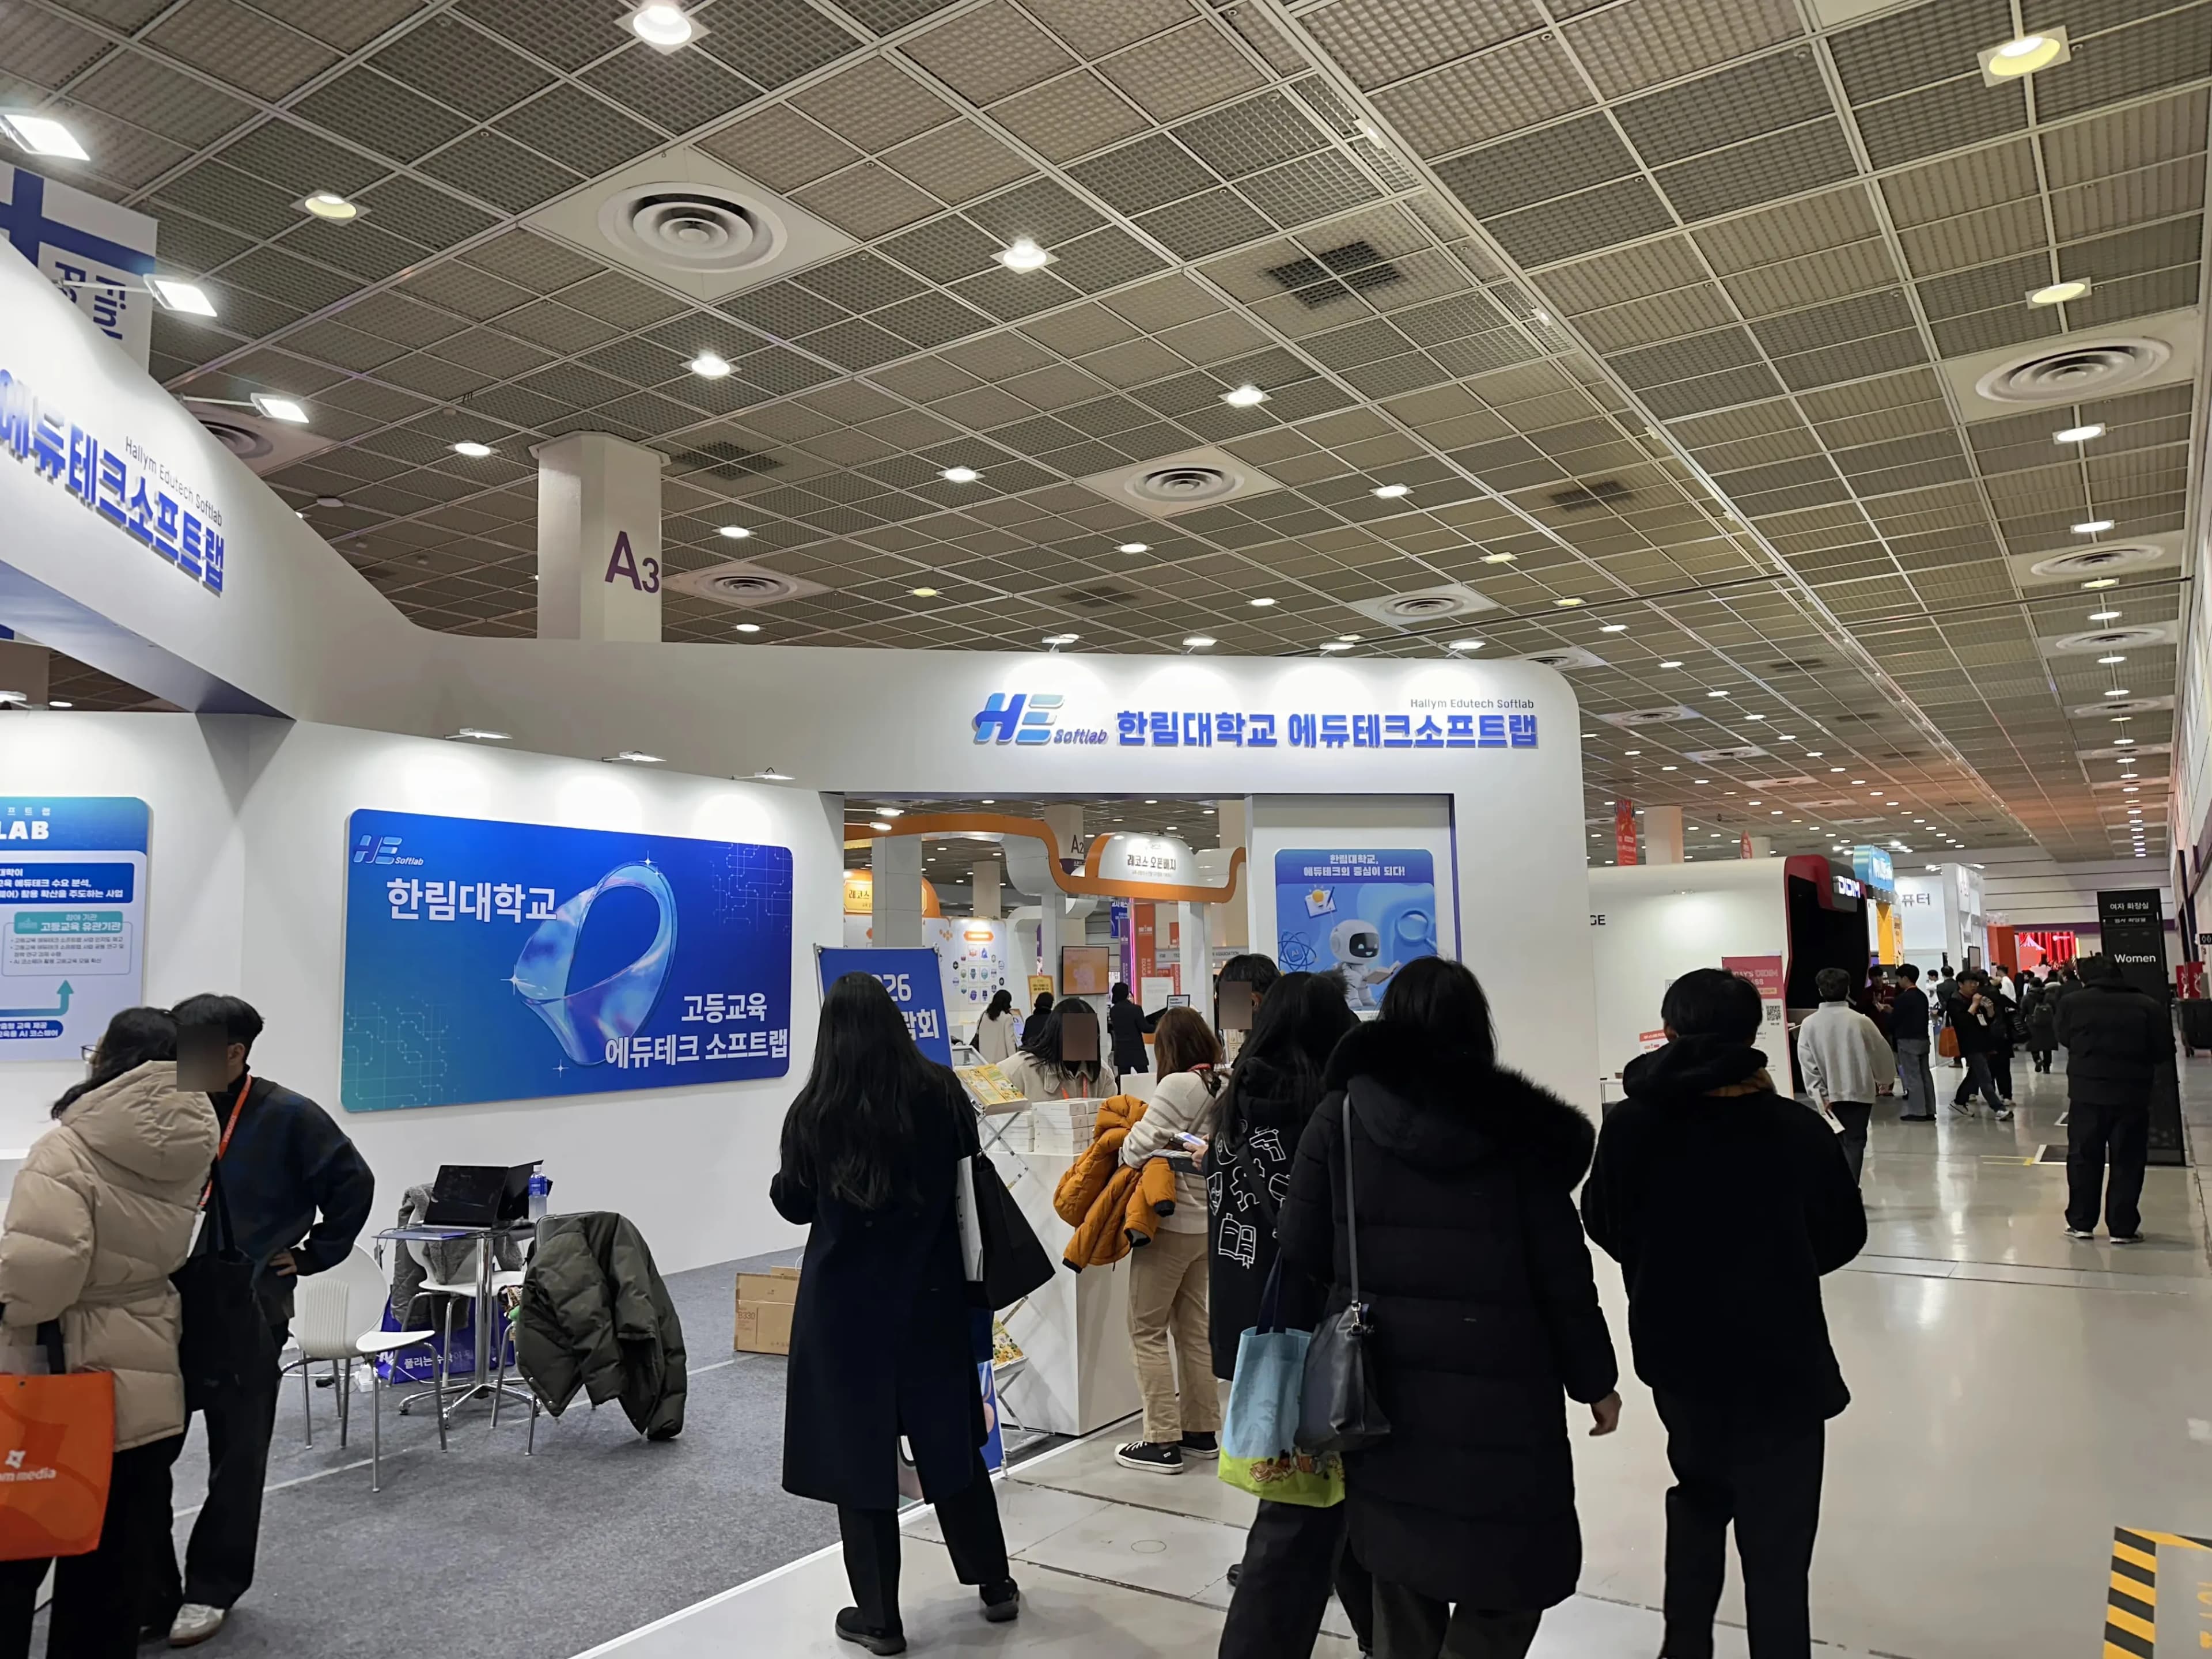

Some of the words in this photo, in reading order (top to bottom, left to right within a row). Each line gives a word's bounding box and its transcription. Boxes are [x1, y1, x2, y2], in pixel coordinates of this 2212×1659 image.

[125, 436, 156, 472] Hallym
[160, 464, 193, 503] Edutech
[196, 494, 222, 527] Softlab
[605, 531, 660, 593] A3
[1411, 699, 1447, 709] Hallym
[1450, 699, 1494, 709] Edutech
[1497, 699, 1534, 709] Softlab
[1116, 710, 1277, 747] 한림대학교
[1054, 728, 1108, 745] Softlab
[395, 856, 424, 866] Softlab
[1127, 854, 1148, 867] 레코스
[1330, 854, 1378, 865] 한림대학교,
[1304, 866, 1350, 877] 에듀테크의
[1384, 866, 1405, 876] 되다!
[14, 879, 50, 888] 에듀테크
[52, 879, 69, 887] 수요
[69, 889, 104, 899] 주도하는
[106, 889, 123, 898] 사업
[387, 877, 557, 923] 한림대학교
[849, 889, 870, 899] 레코스
[1902, 893, 1930, 907] 퓨터
[2127, 902, 2149, 910] 화장실
[40, 922, 81, 931] 고등교육
[82, 922, 121, 931] 유관기관
[2114, 954, 2156, 964] Women
[681, 993, 767, 1024] 고등교육
[605, 1034, 699, 1069] 에듀테크
[705, 1028, 788, 1060] 소프트랩
[16, 1467, 56, 1480] media
